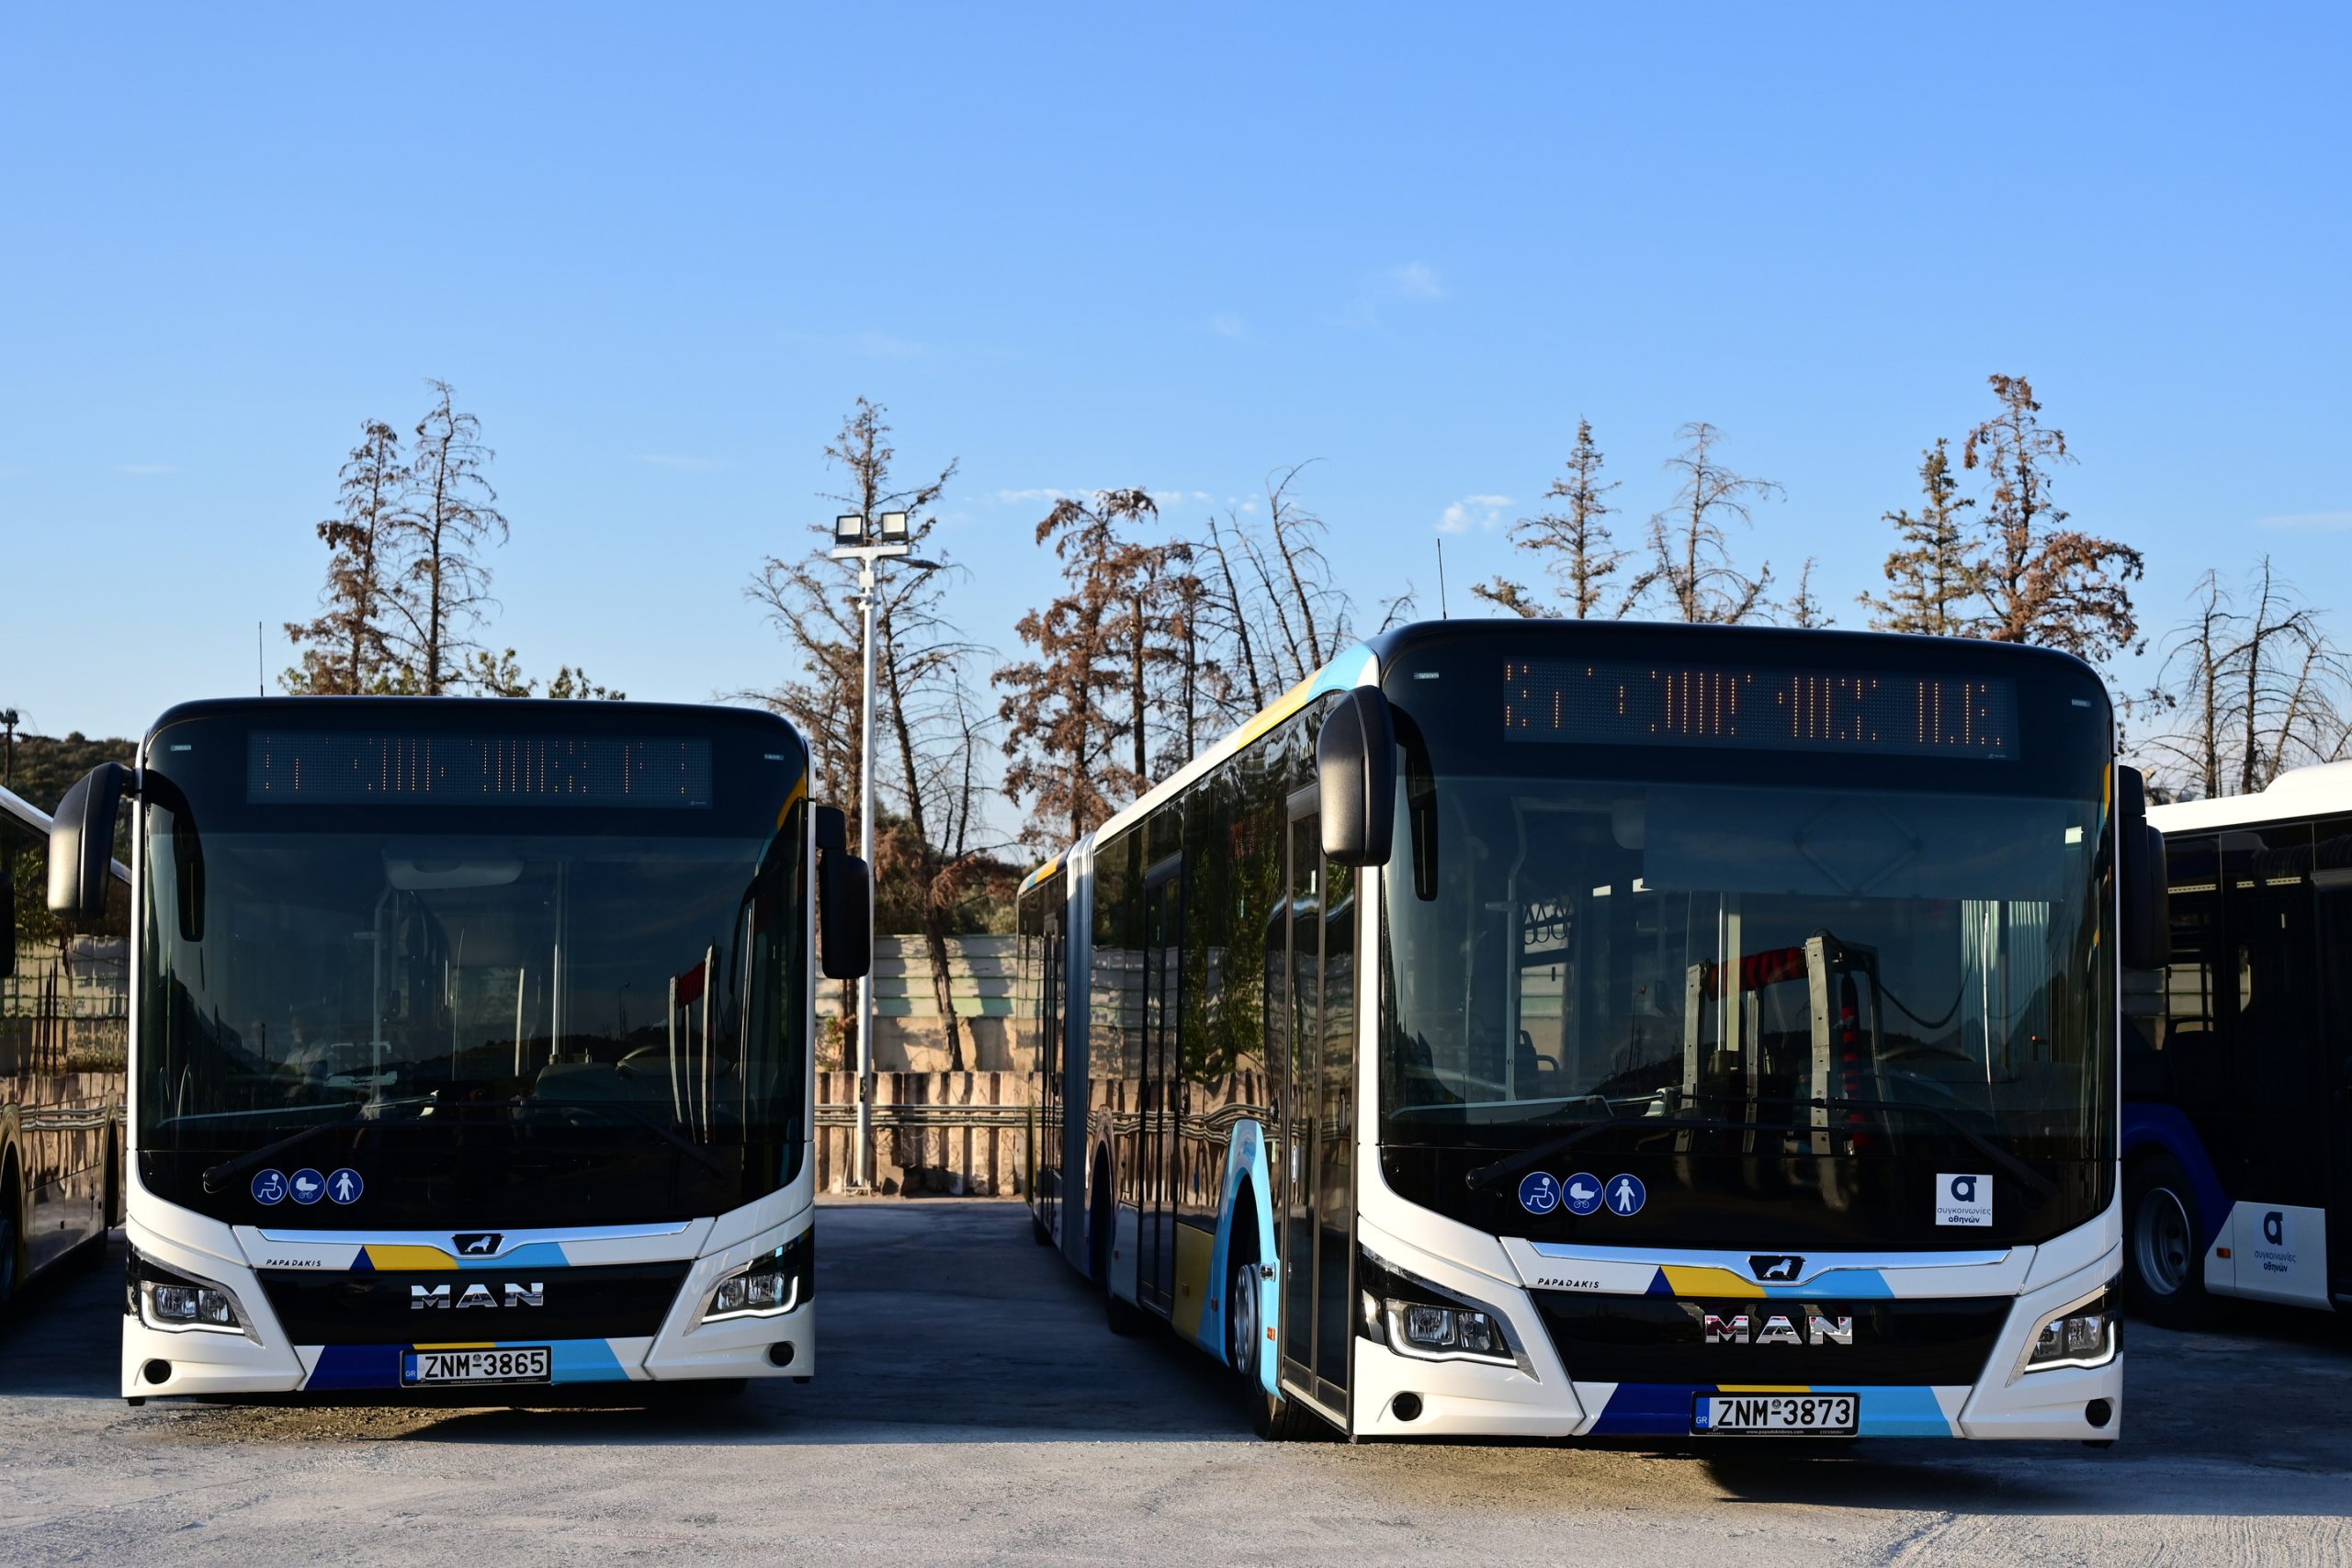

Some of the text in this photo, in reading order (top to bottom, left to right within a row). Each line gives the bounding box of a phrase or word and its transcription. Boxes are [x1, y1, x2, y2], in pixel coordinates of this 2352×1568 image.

[1937, 1206, 1992, 1216] συγκοινωνίες
[1948, 1215, 1980, 1224] αθηνών
[266, 1258, 322, 1267] PAPADAKIS
[1537, 1277, 1600, 1289] PAPADAKIS
[410, 1282, 544, 1310] MAN
[1703, 1314, 1853, 1346] MAN
[424, 1351, 544, 1379] ZNM-3865
[405, 1370, 416, 1378] GR
[1717, 1399, 1851, 1427] ZNM-3873
[1695, 1416, 1708, 1424] GR
